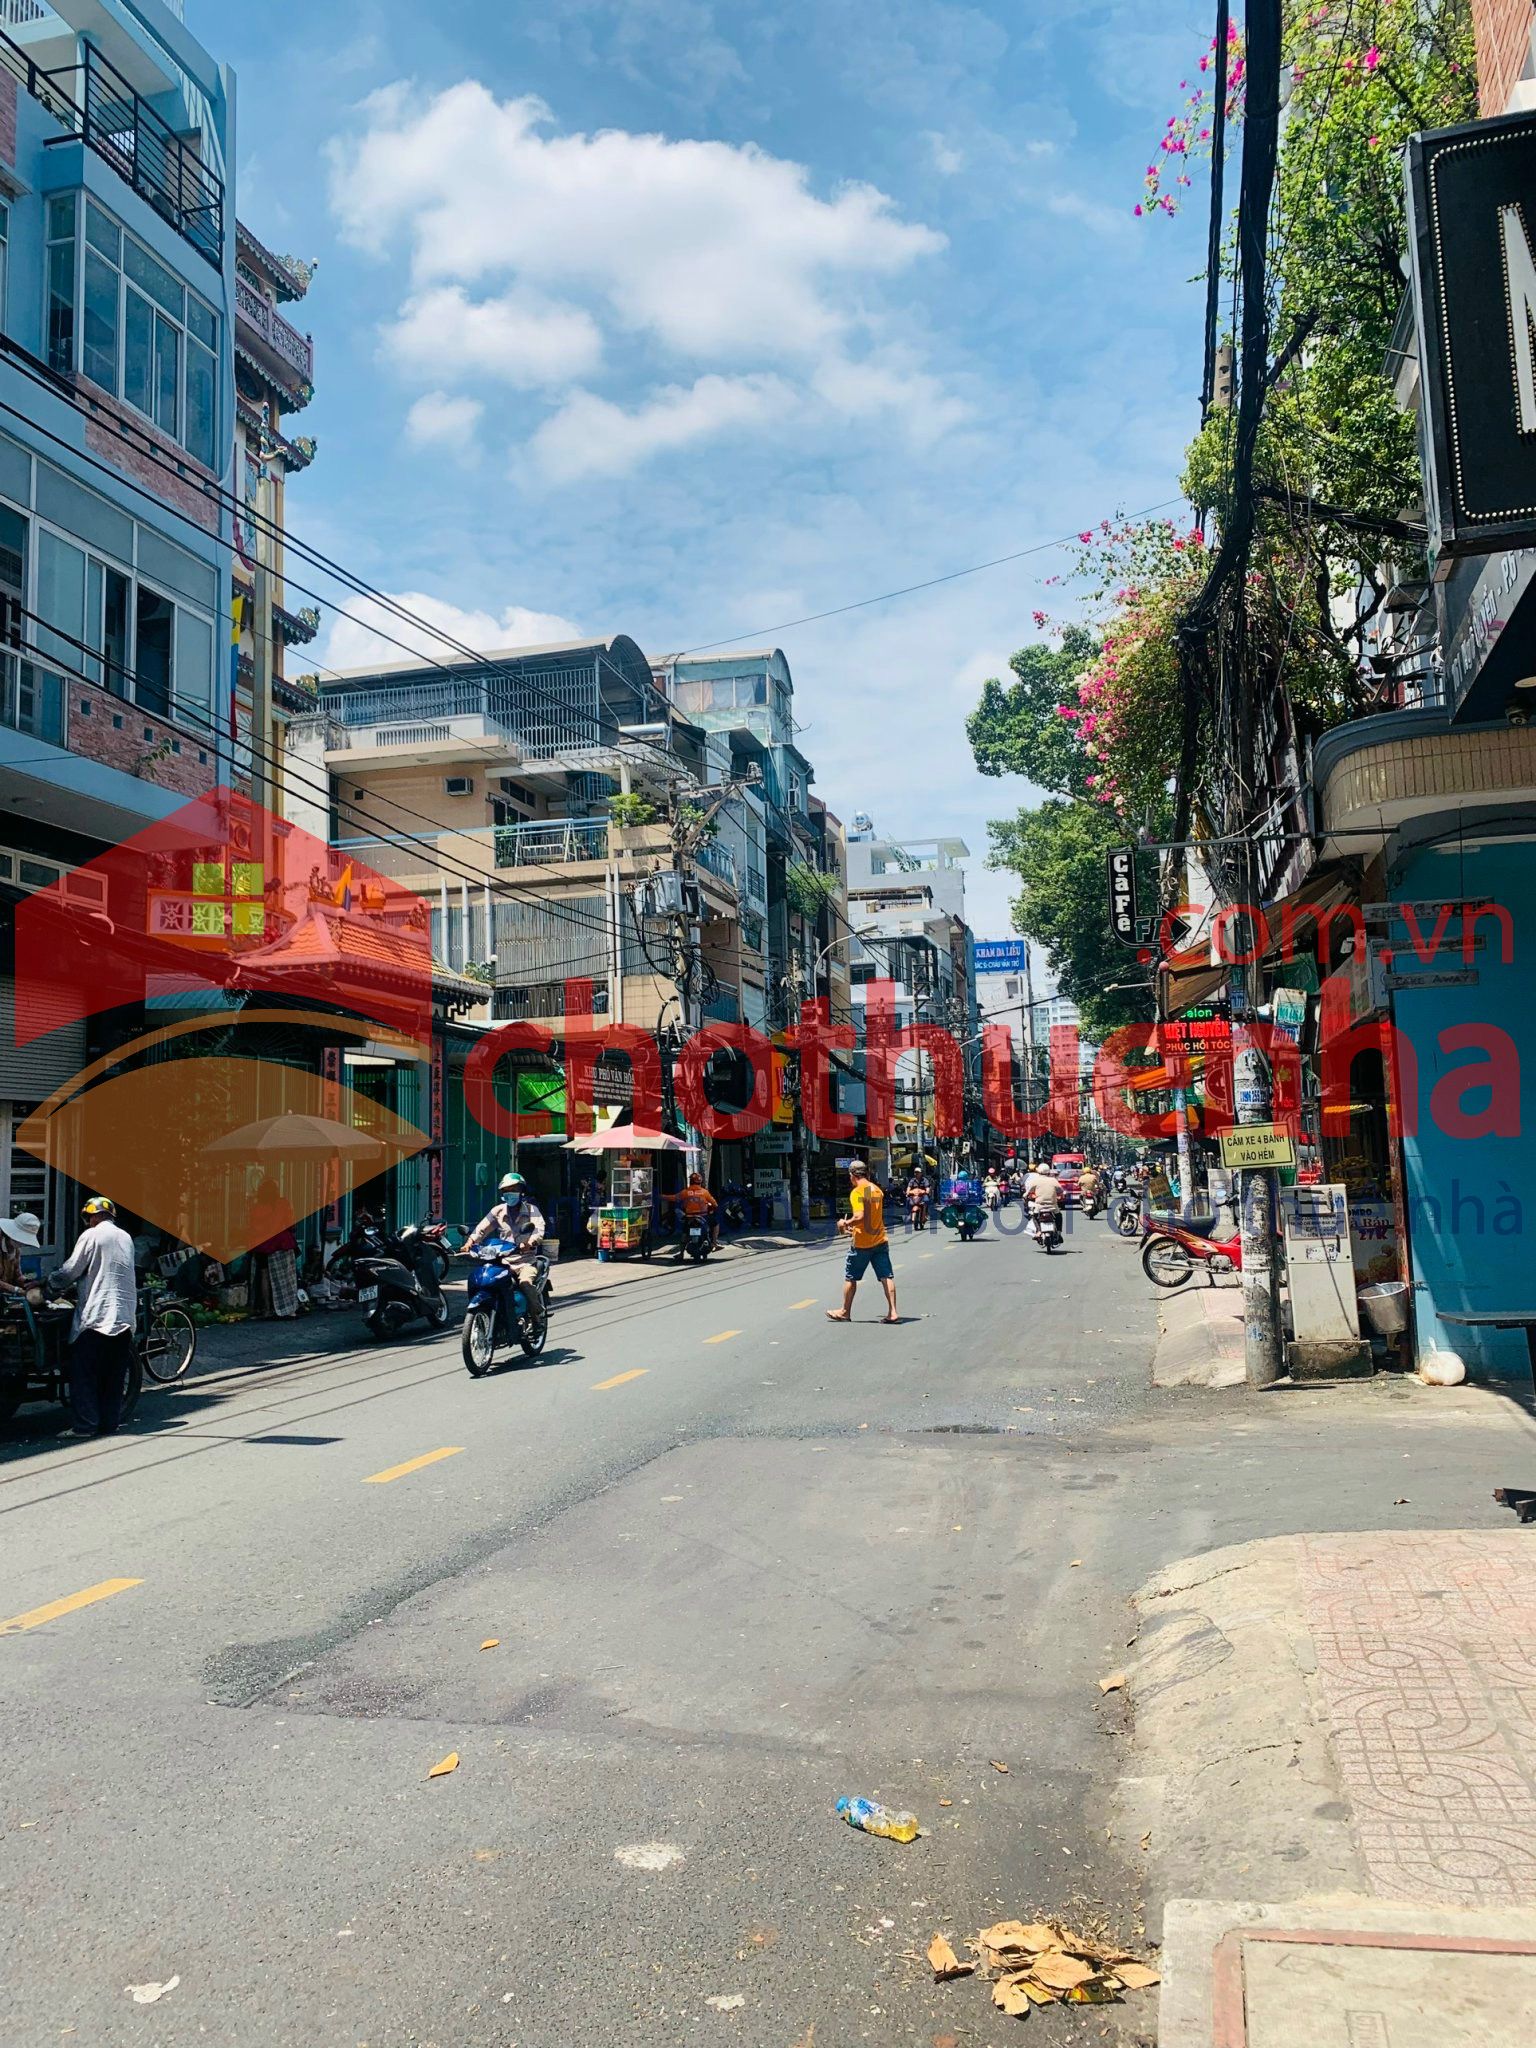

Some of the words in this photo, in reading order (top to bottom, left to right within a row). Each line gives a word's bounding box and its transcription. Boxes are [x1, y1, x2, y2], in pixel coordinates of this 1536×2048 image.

[1134, 918, 1174, 942] FA
[996, 947, 1005, 957] DA
[1432, 974, 1469, 984] AWAY
[1181, 1008, 1213, 1019] alon
[1211, 1040, 1231, 1050] TÓC
[584, 1065, 598, 1079] KHU
[611, 1067, 623, 1083] VĂN
[1246, 1135, 1256, 1146] XE
[1257, 1135, 1262, 1145] 4
[1240, 1149, 1257, 1161] VÀO
